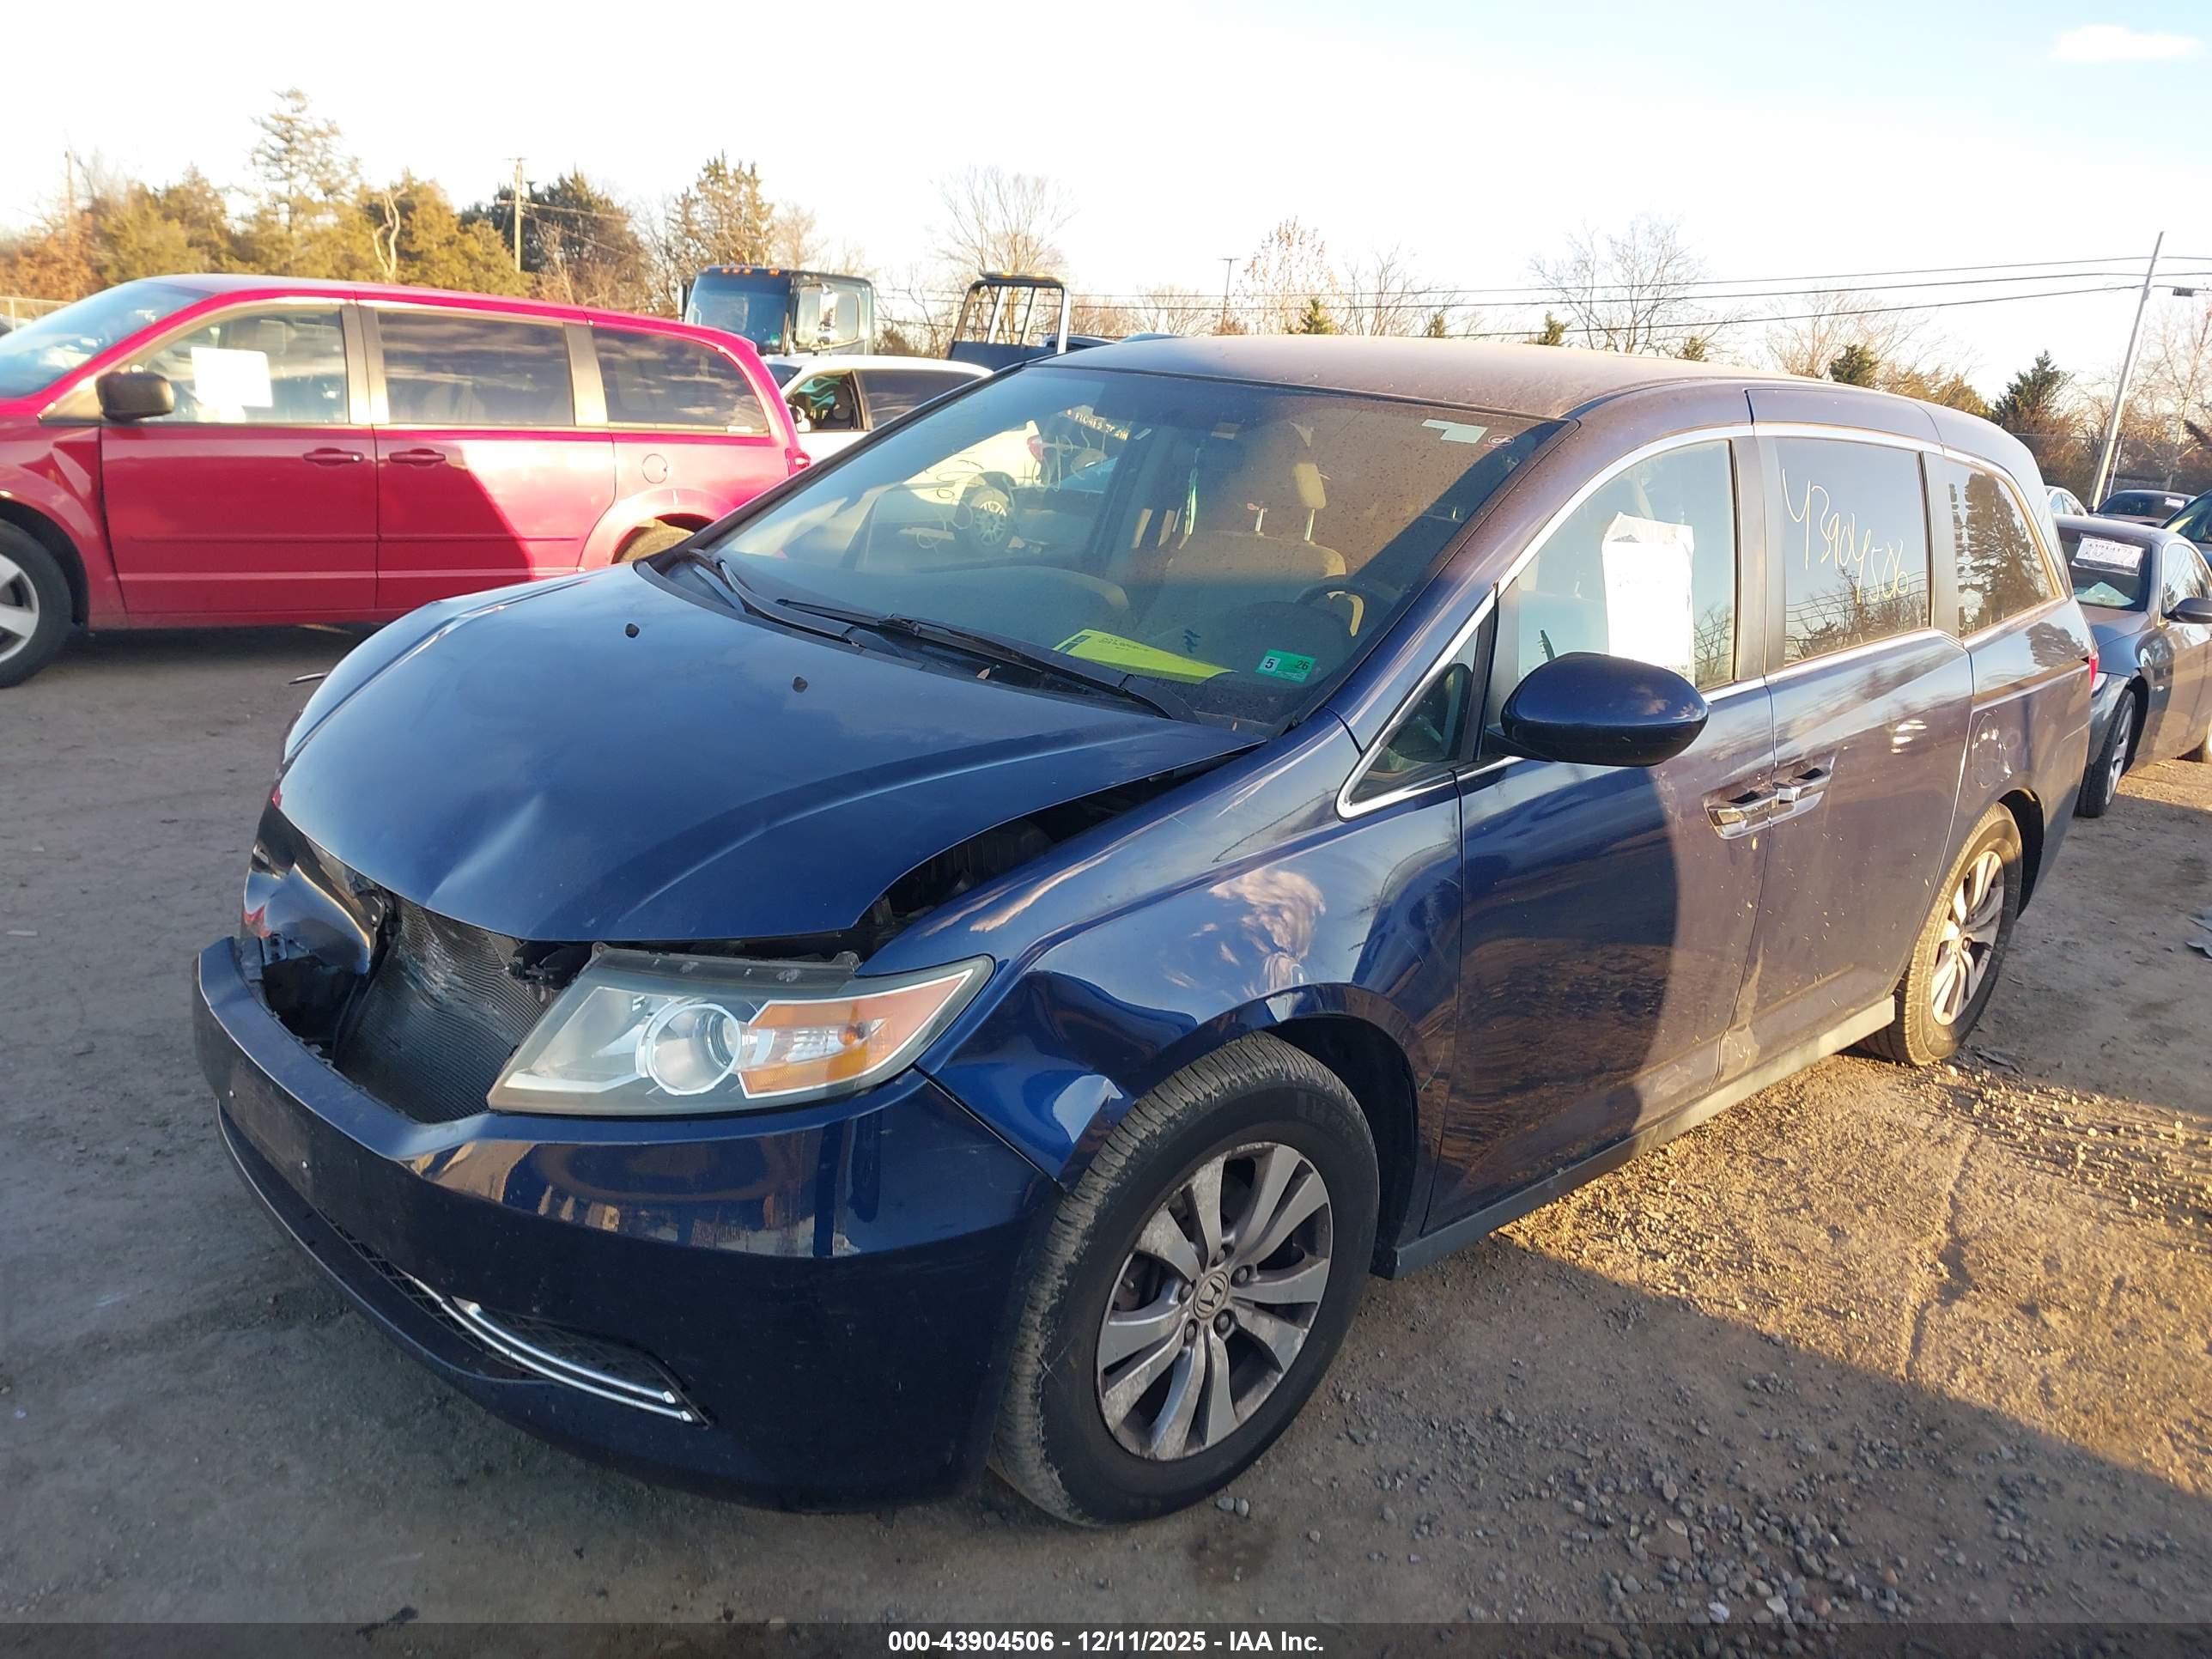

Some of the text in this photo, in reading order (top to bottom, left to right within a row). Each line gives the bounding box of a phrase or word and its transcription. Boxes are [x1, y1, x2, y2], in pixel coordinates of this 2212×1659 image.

[1782, 467, 1910, 605] 43904506
[1264, 658, 1310, 671] 5 26
